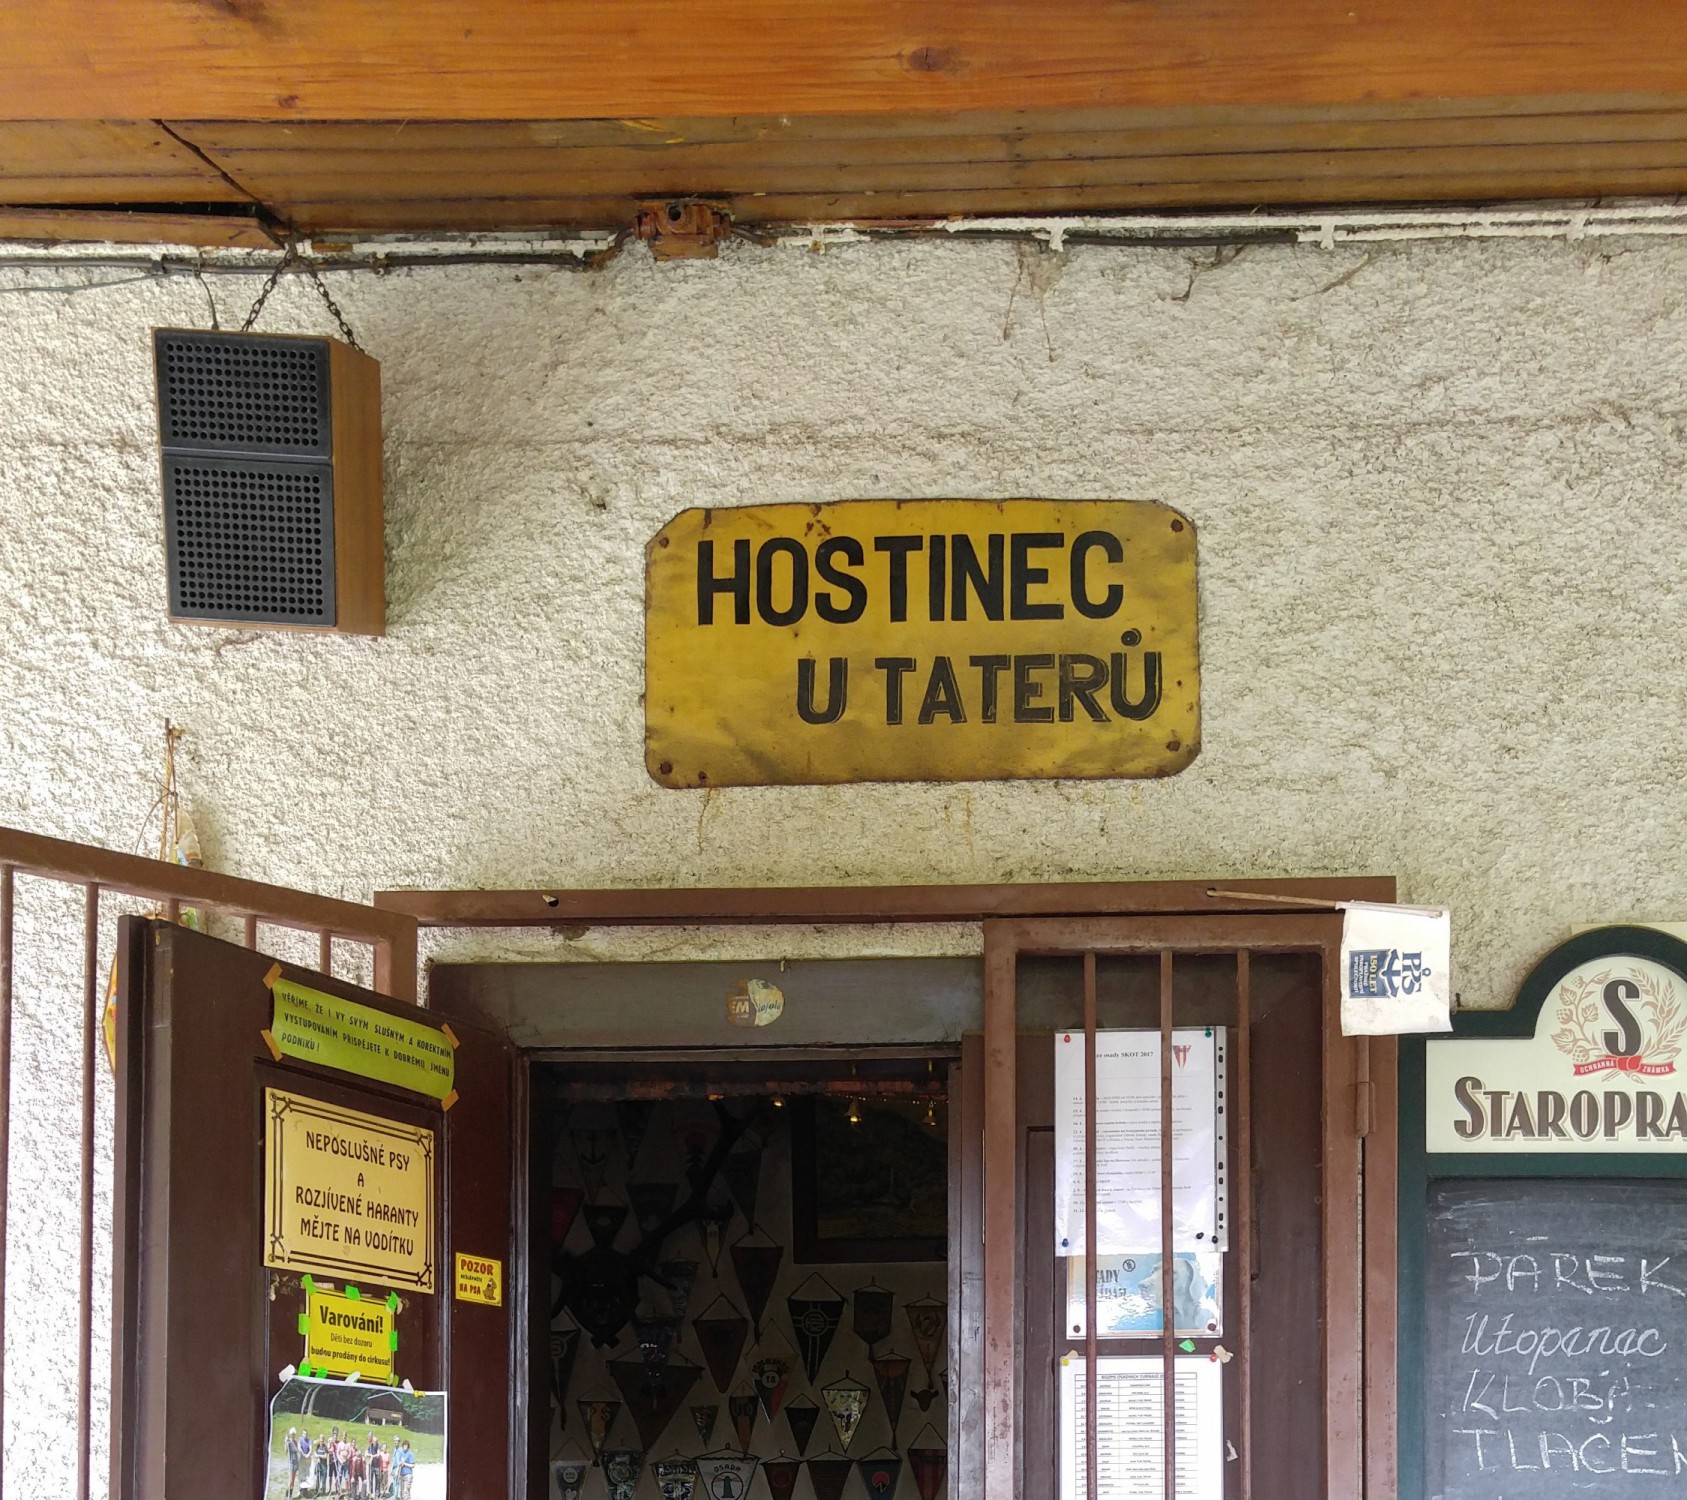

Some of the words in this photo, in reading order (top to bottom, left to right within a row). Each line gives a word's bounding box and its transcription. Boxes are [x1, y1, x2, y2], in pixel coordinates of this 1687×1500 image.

[697, 530, 1125, 628] HOSTINEC
[796, 656, 849, 726] U
[873, 627, 1165, 726] TATERŮ
[1603, 979, 1642, 1057] S
[374, 1024, 405, 1043] SLUŠNÝM
[408, 1037, 413, 1046] A
[1579, 1059, 1615, 1073] OCHRANNÁ
[1642, 1065, 1670, 1074] ZNÁMKA
[1454, 1076, 1687, 1141] STAROPRA
[306, 1130, 385, 1166] NEPOSLUŠNÉ
[389, 1151, 410, 1172] PSY
[357, 1172, 364, 1187] A
[295, 1185, 363, 1216] ROZJÍVENÉ
[366, 1200, 419, 1228] HARANTY
[300, 1214, 340, 1242] MĚJTE
[344, 1226, 361, 1246] NA
[365, 1230, 414, 1256] VODÍTKU
[461, 1258, 494, 1276] POZOR
[1096, 1269, 1121, 1283] ADY
[319, 1305, 384, 1334] Varování!
[330, 1333, 343, 1342] Děti
[343, 1335, 353, 1345] bez
[353, 1337, 373, 1348] dozoru
[311, 1346, 331, 1357] budou
[332, 1350, 358, 1363] prodány
[358, 1354, 367, 1362] do
[713, 1463, 742, 1473] OSADA
